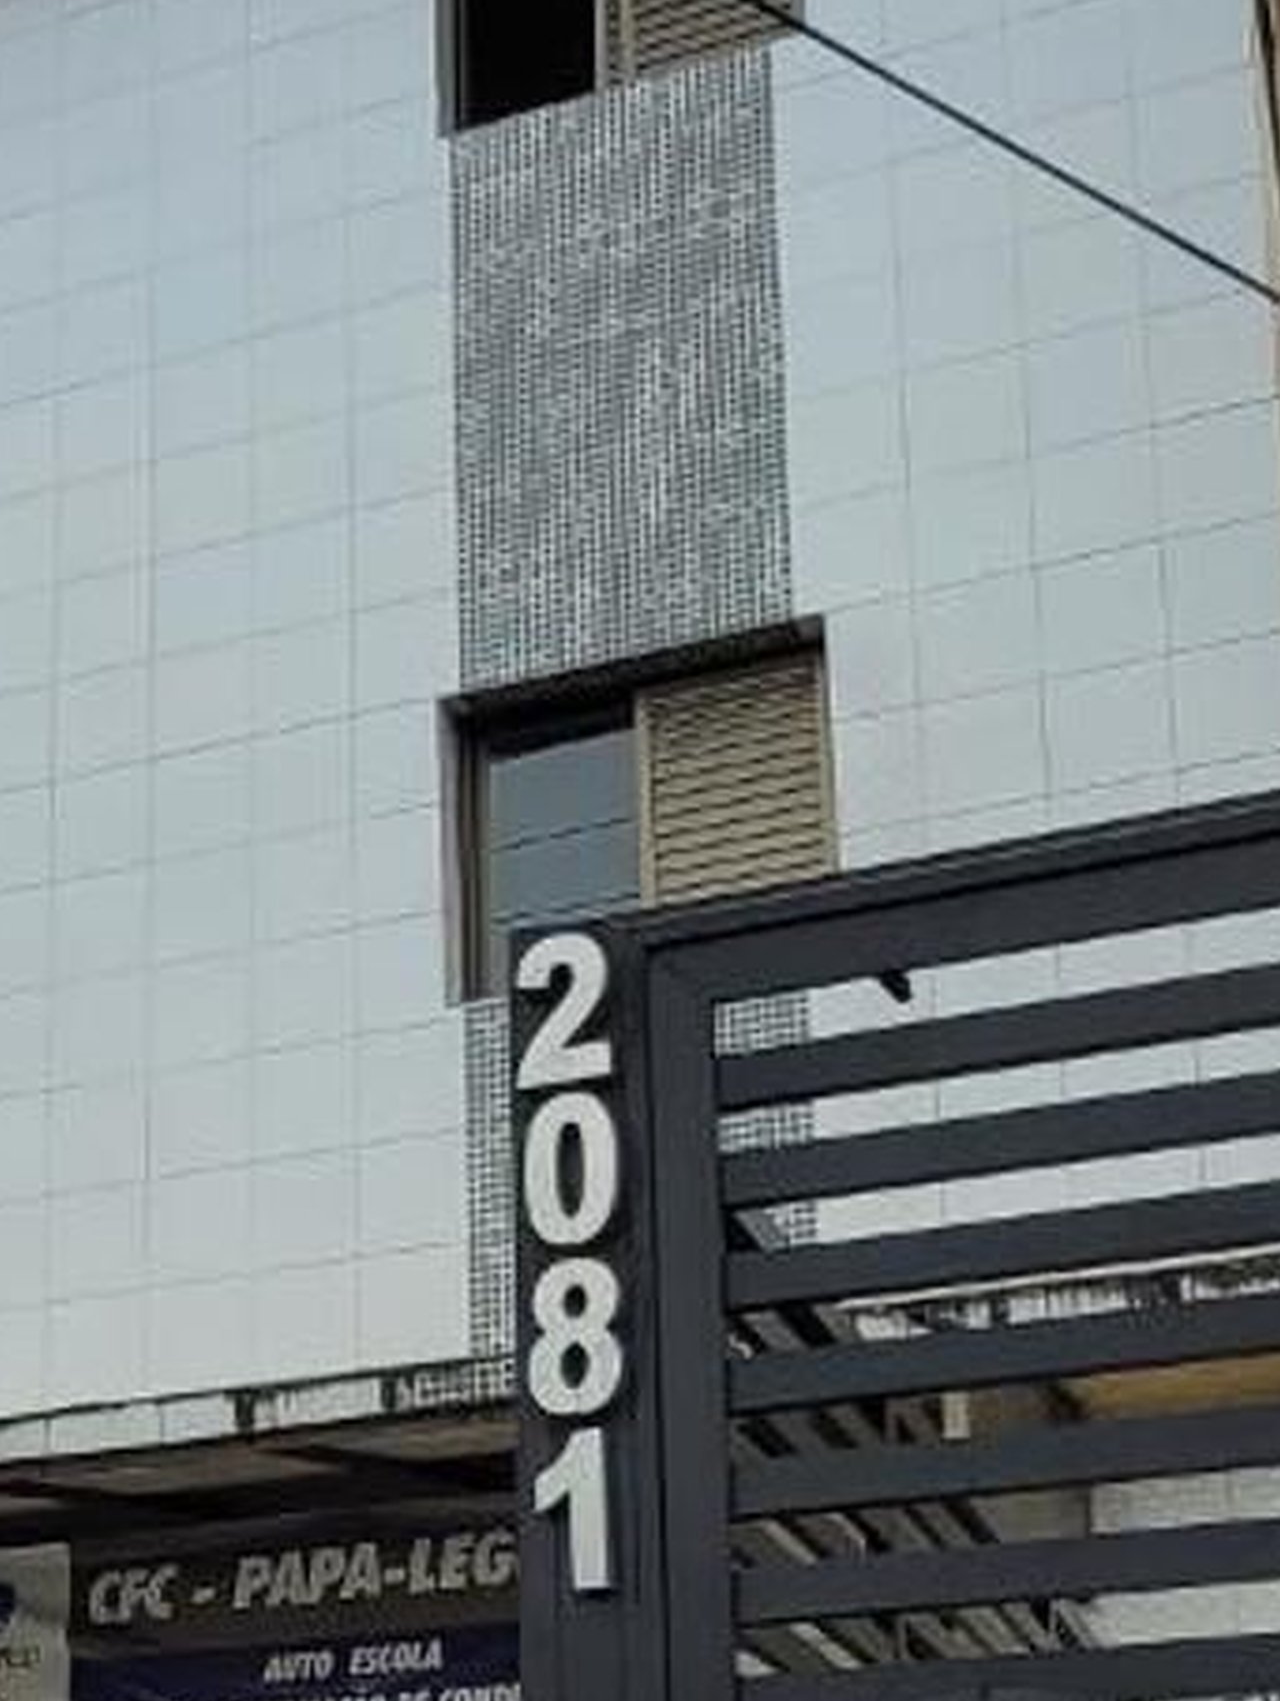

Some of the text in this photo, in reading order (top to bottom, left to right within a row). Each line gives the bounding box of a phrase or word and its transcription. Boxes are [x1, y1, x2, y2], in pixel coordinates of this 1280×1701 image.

[516, 931, 622, 1591] 2081
[88, 1562, 178, 1626] CFC
[263, 1639, 444, 1683] AUTO ESCOLA
